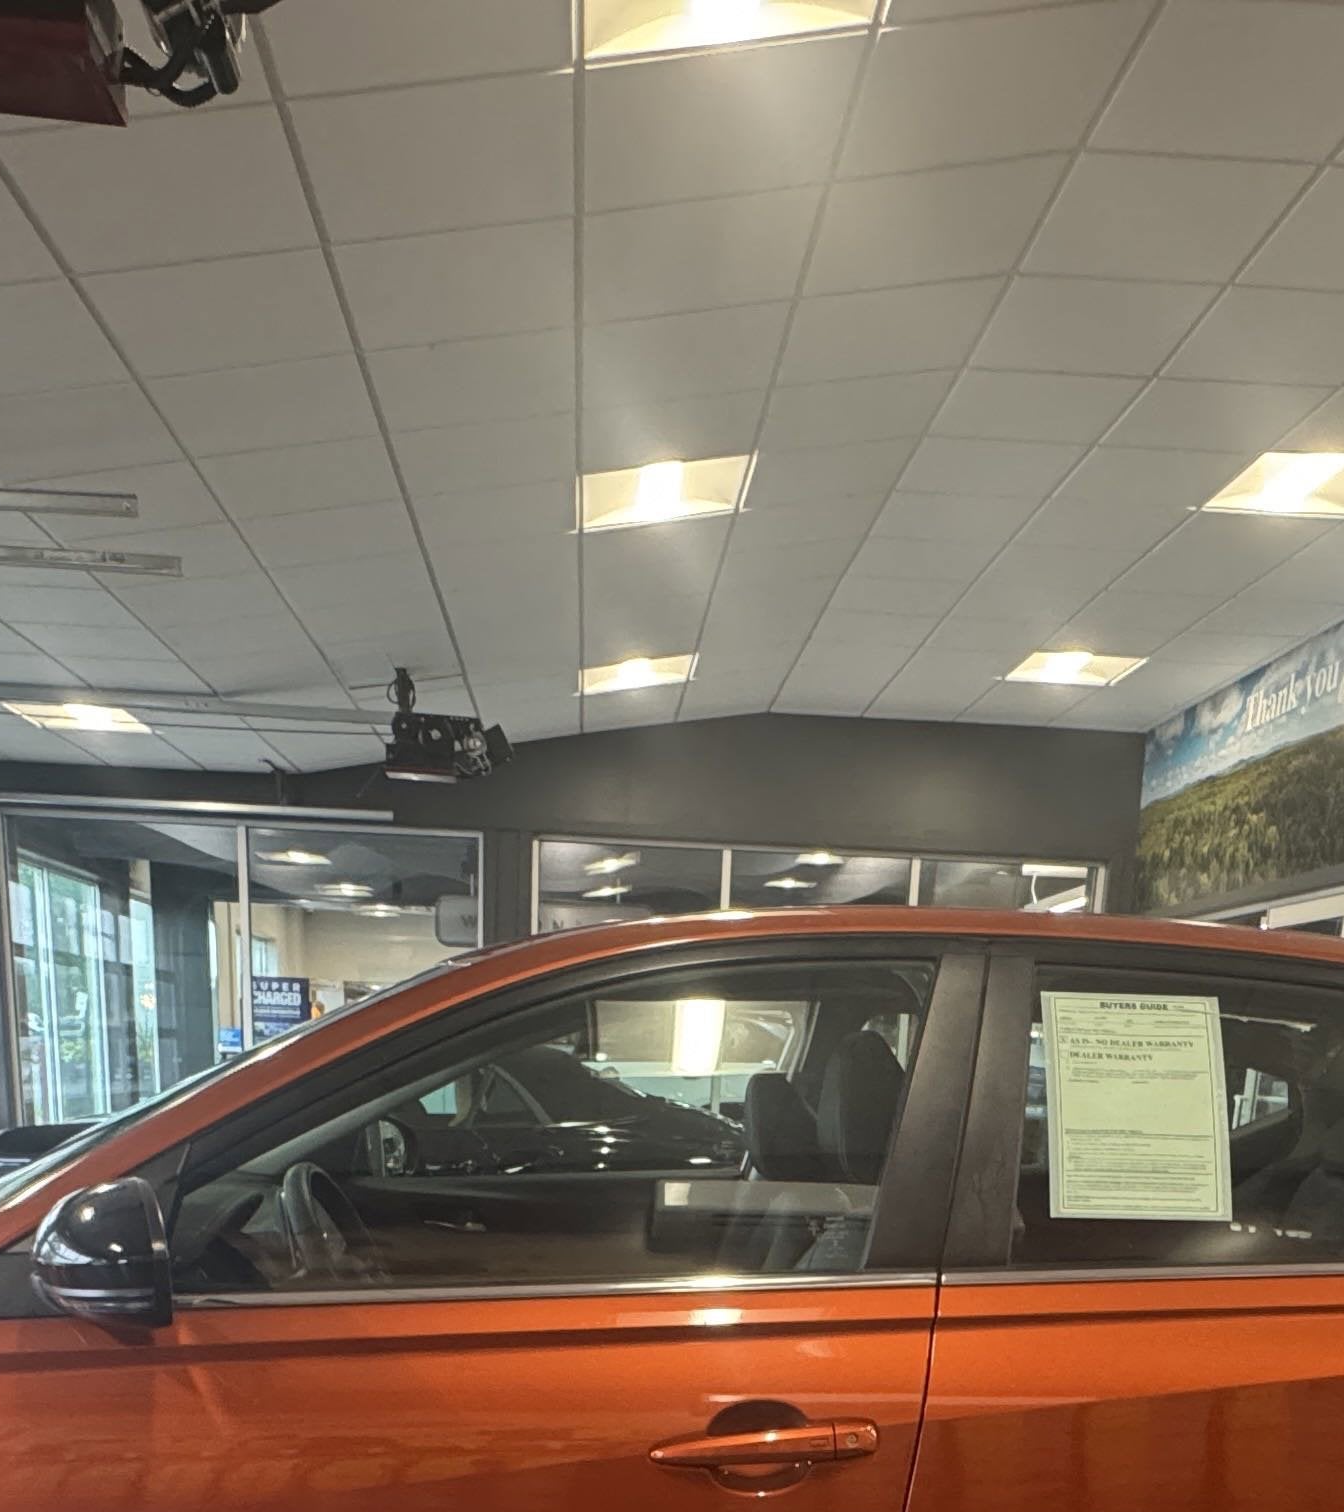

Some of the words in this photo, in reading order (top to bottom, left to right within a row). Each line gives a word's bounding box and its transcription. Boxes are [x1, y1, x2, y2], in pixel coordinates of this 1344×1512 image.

[1245, 672, 1298, 732] Thank
[1302, 660, 1341, 714] you
[1099, 1002, 1137, 1010] BUYERS
[1139, 1003, 1169, 1011] GUIDE
[1109, 1038, 1144, 1047] DEALER
[1145, 1040, 1194, 1048] WARRANTY
[1069, 1051, 1103, 1059] DEALER
[1104, 1052, 1154, 1061] WARRANTY
